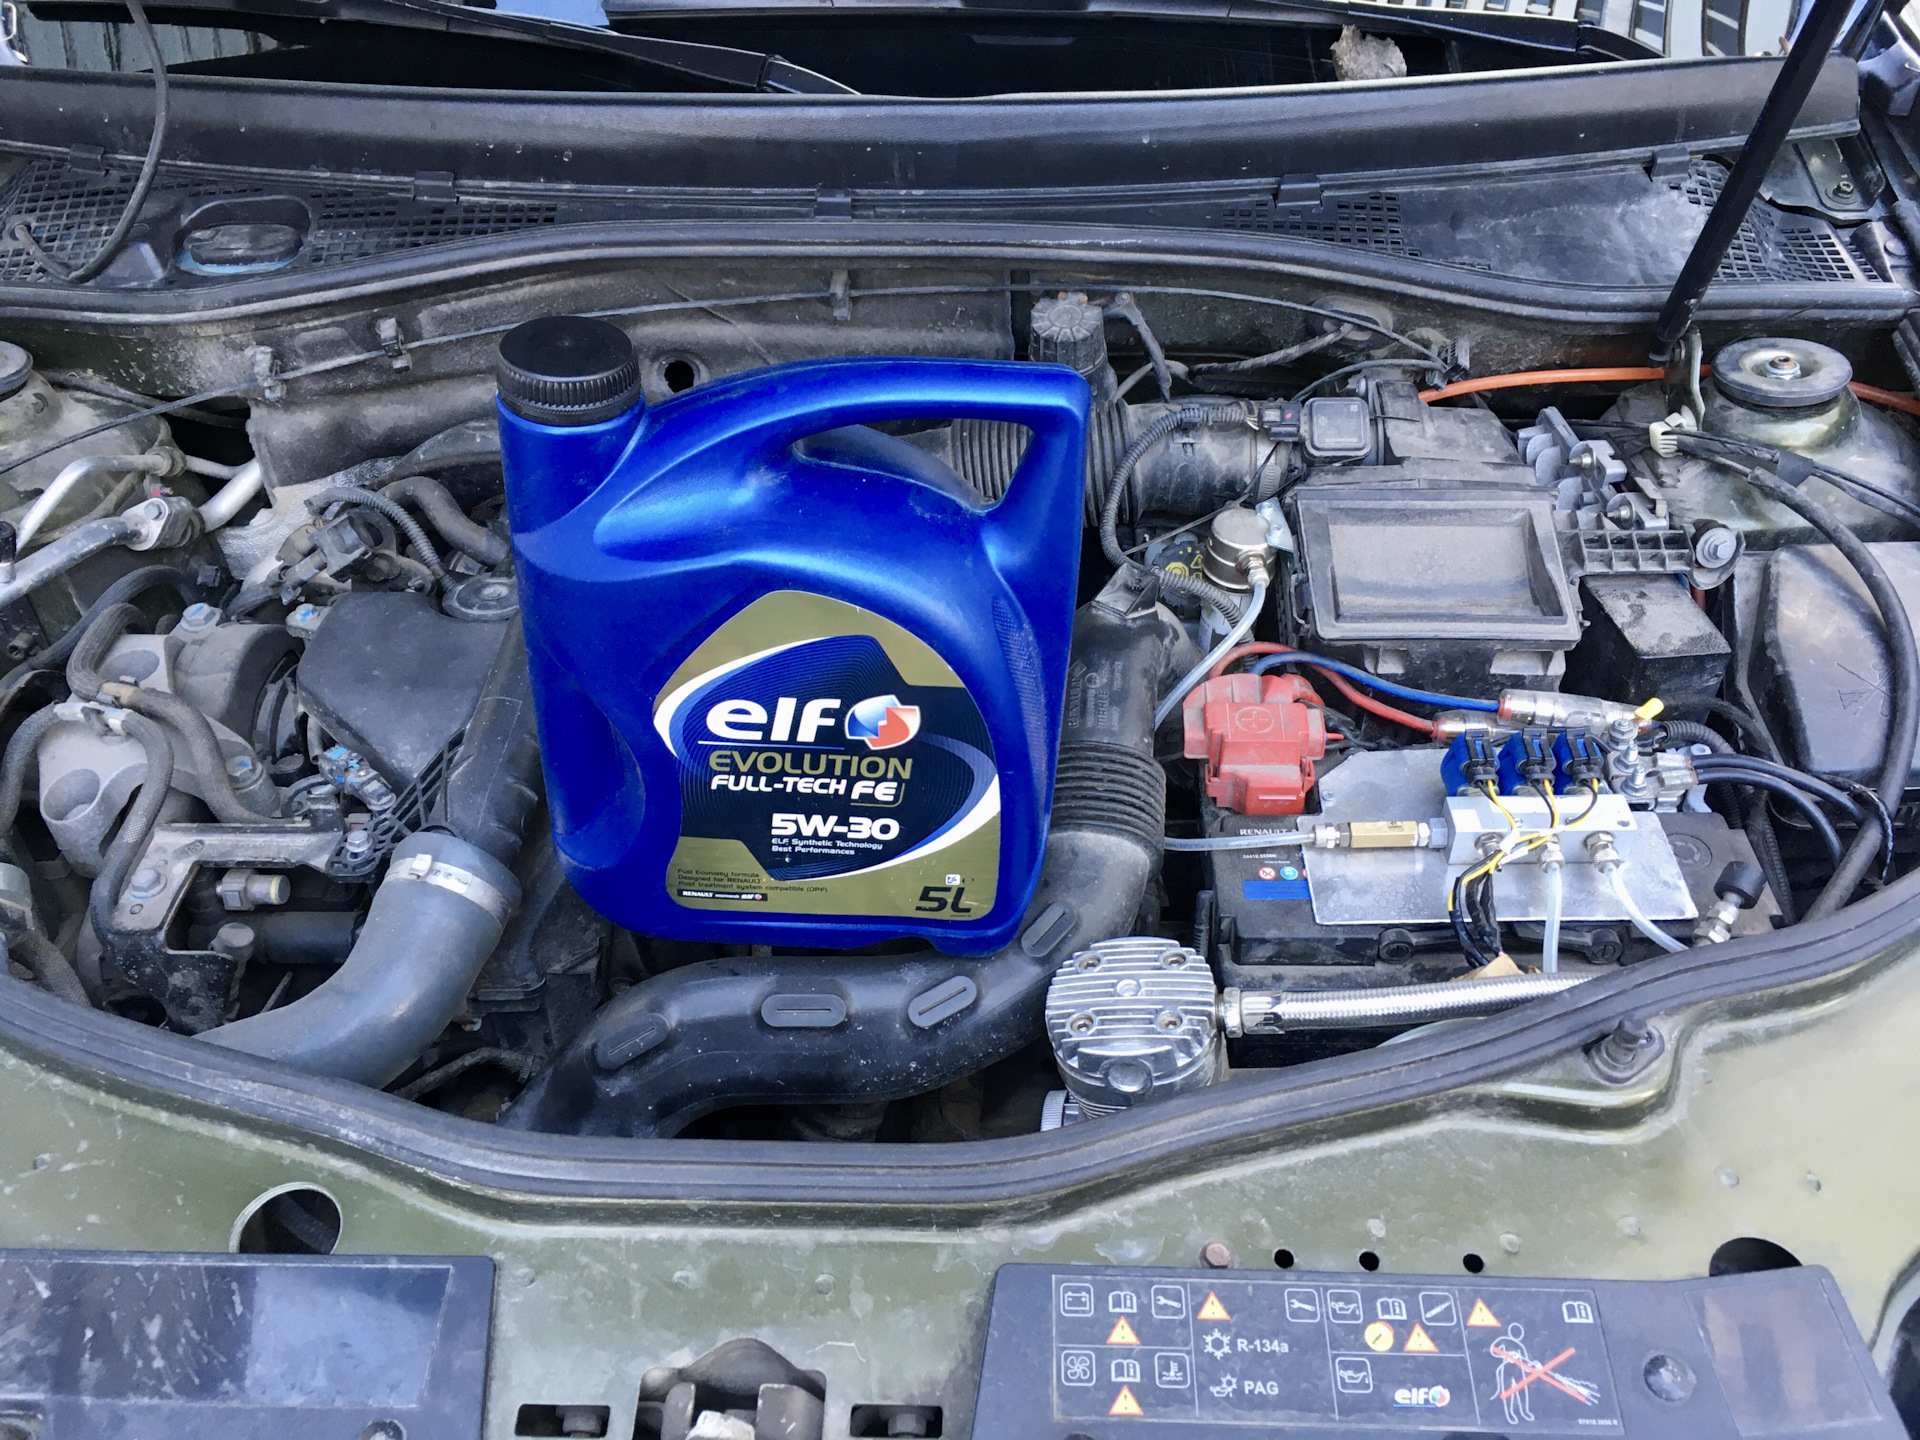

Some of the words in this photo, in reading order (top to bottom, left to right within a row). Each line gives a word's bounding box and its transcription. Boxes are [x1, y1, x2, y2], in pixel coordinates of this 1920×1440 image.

[706, 697, 841, 742] elf
[709, 750, 913, 780] EVOLUTION
[711, 775, 847, 795] FULL-TECH
[851, 781, 898, 802] FE
[771, 813, 900, 841] 5W-30
[1240, 828, 1288, 836] RENAULT
[791, 838, 833, 847] Synthetic
[835, 840, 883, 850] Technology
[795, 846, 856, 855] Performances
[677, 874, 710, 882] Designed
[695, 870, 729, 878] Economy
[682, 890, 714, 898] RENAULT
[698, 881, 733, 889] treatment
[765, 885, 805, 893] compatible
[915, 886, 972, 913] 5L
[1236, 1338, 1290, 1353] R-134a
[1243, 1380, 1279, 1395] PAG
[1394, 1387, 1430, 1405] elf
